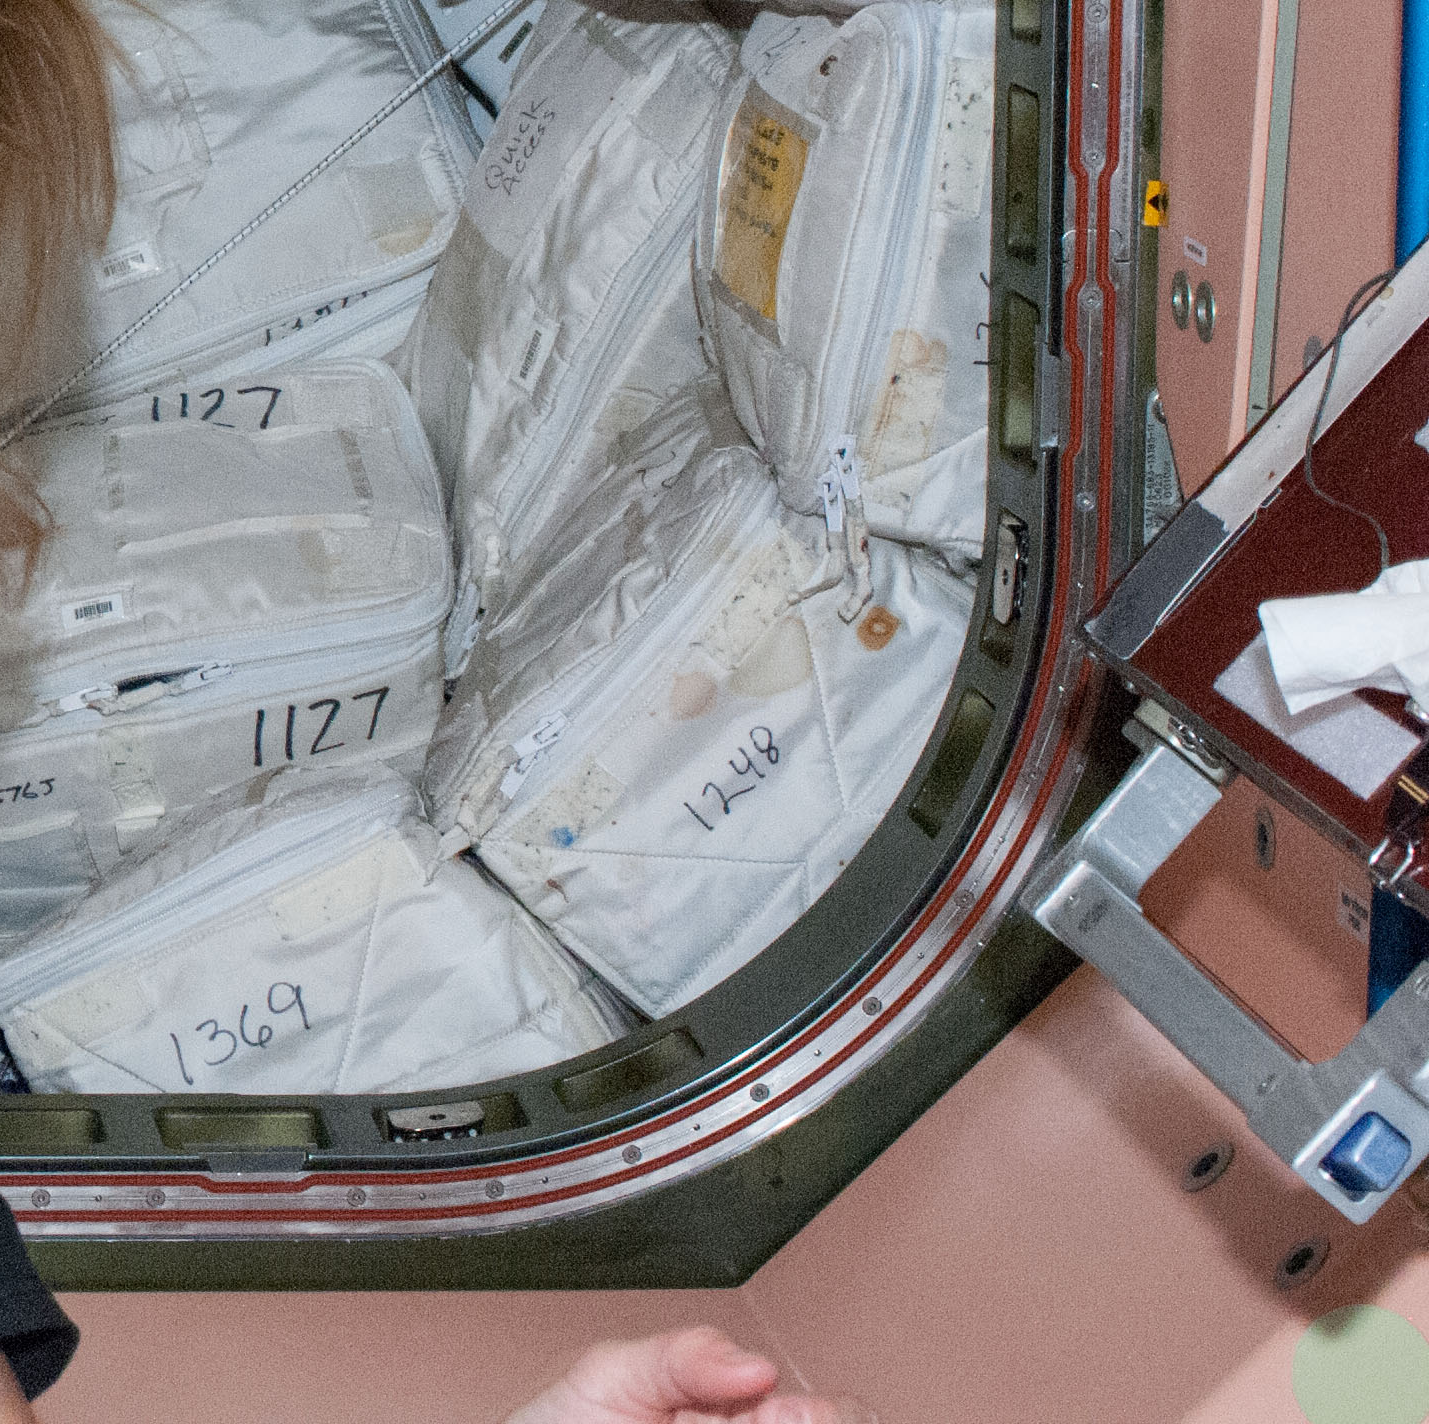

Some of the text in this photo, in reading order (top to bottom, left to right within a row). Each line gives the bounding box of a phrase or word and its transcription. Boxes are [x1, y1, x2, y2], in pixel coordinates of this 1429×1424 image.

[485, 96, 547, 190] Quick
[502, 107, 557, 196] Access
[150, 386, 283, 430] 1127
[252, 686, 391, 766] 1127
[682, 725, 781, 831] 1248
[169, 981, 312, 1086] 1369
